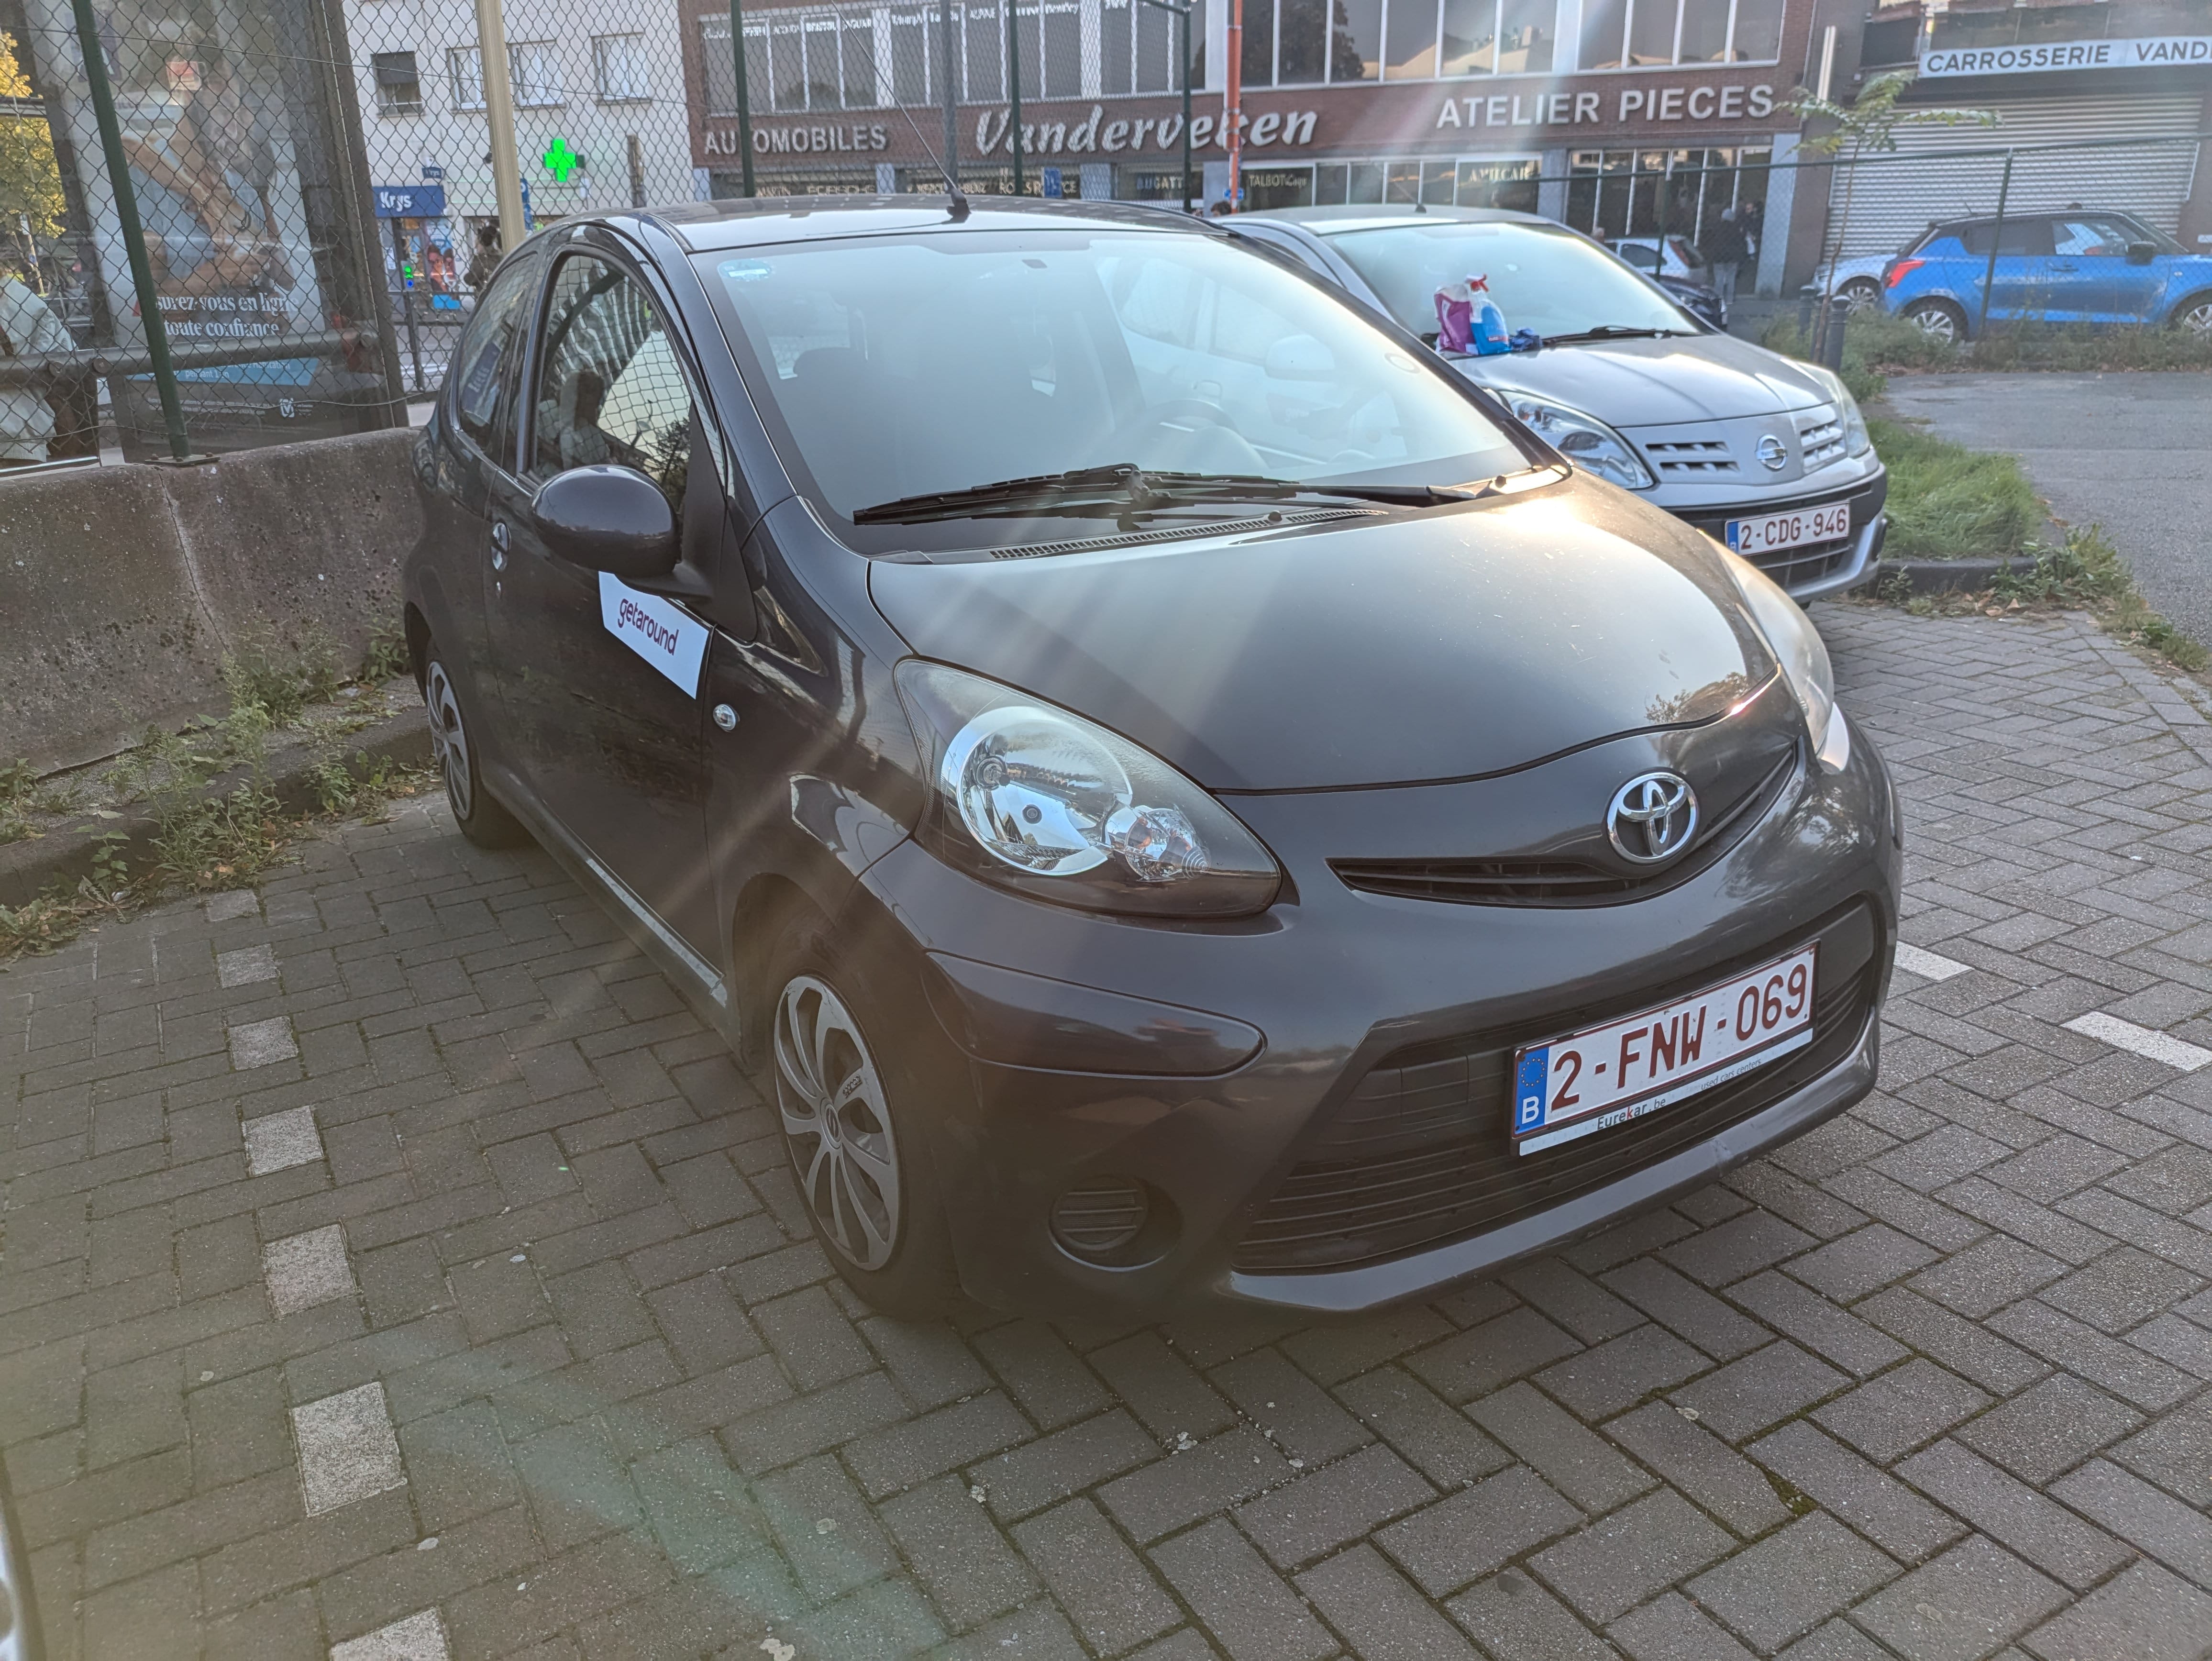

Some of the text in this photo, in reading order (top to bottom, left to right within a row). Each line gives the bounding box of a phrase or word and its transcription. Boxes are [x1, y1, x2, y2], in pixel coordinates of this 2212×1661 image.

[1926, 41, 2212, 73] CARROSSERIE VAND
[1436, 85, 1774, 129] ATELIER PIECES
[705, 125, 887, 155] AUOMOBILES
[975, 104, 1318, 156] Vanderveken
[1136, 175, 1183, 190] BUGATT
[1249, 173, 1286, 188] TALBOT
[379, 191, 413, 212] Krys
[238, 297, 258, 311] en
[258, 292, 300, 317] ligne
[164, 318, 280, 337] toute confiance
[185, 370, 214, 378] pendant
[1740, 509, 1847, 550] 2-CDG-946
[618, 598, 679, 656] getaround
[1551, 963, 1806, 1112] 2-FNW-069
[1701, 1075, 1719, 1091] used
[1720, 1068, 1735, 1082] cars
[1736, 1058, 1761, 1075] centers
[1521, 1096, 1539, 1125] B
